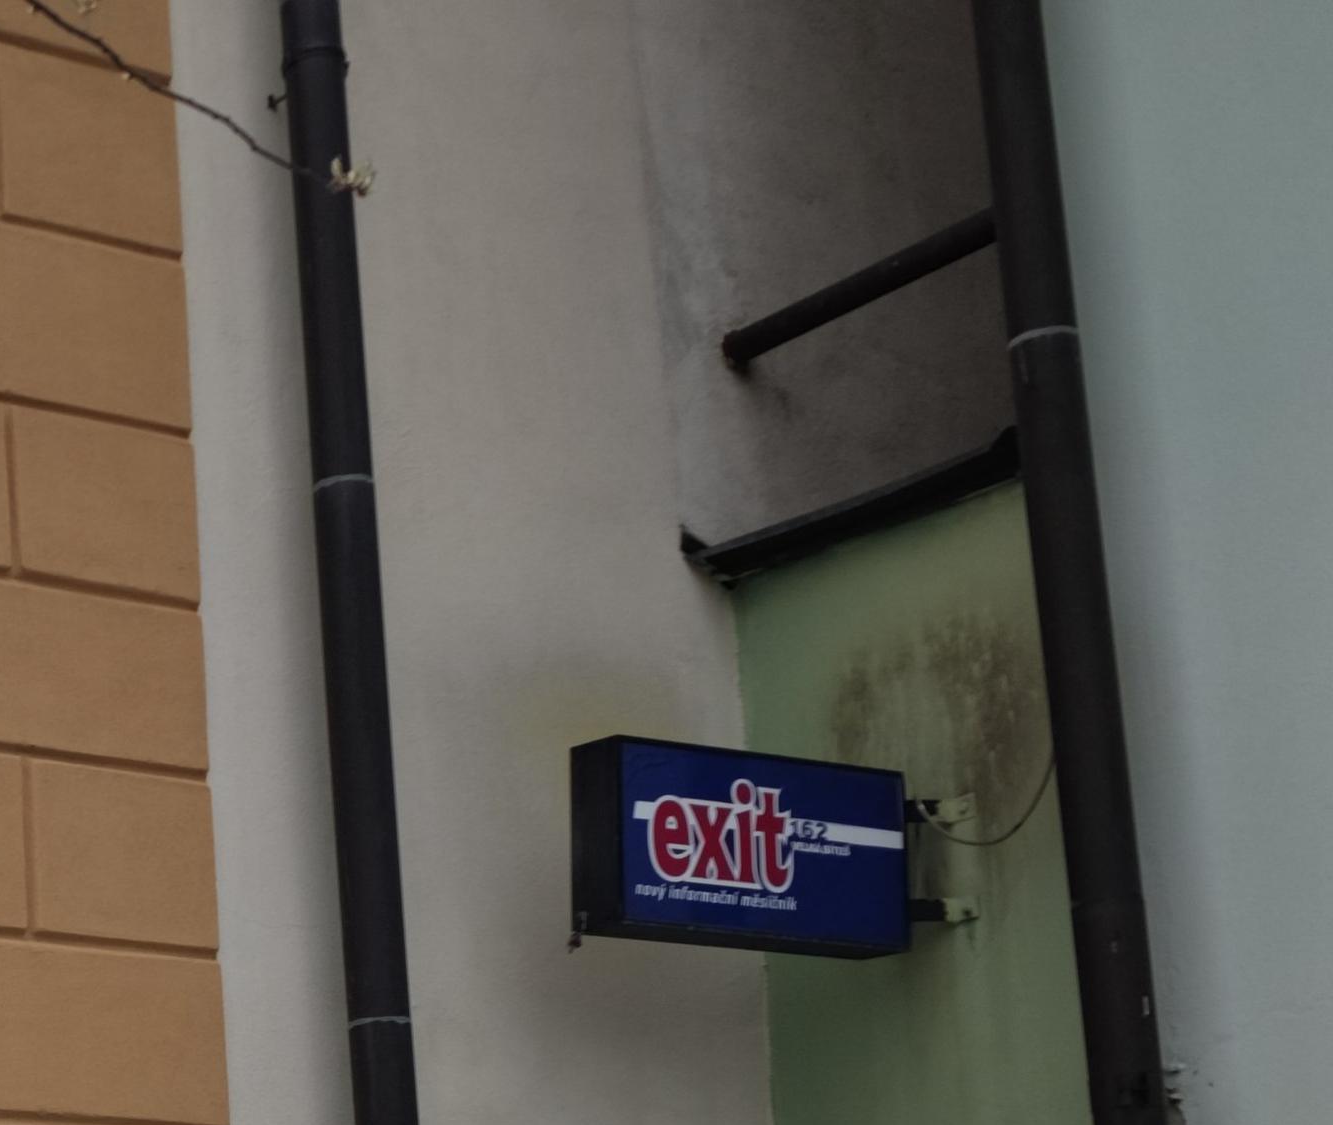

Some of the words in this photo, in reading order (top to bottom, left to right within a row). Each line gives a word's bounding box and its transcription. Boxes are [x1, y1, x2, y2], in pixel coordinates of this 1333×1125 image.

[648, 779, 794, 893] exit
[789, 820, 828, 842] 162
[634, 883, 666, 901] nový
[668, 884, 738, 906] informační
